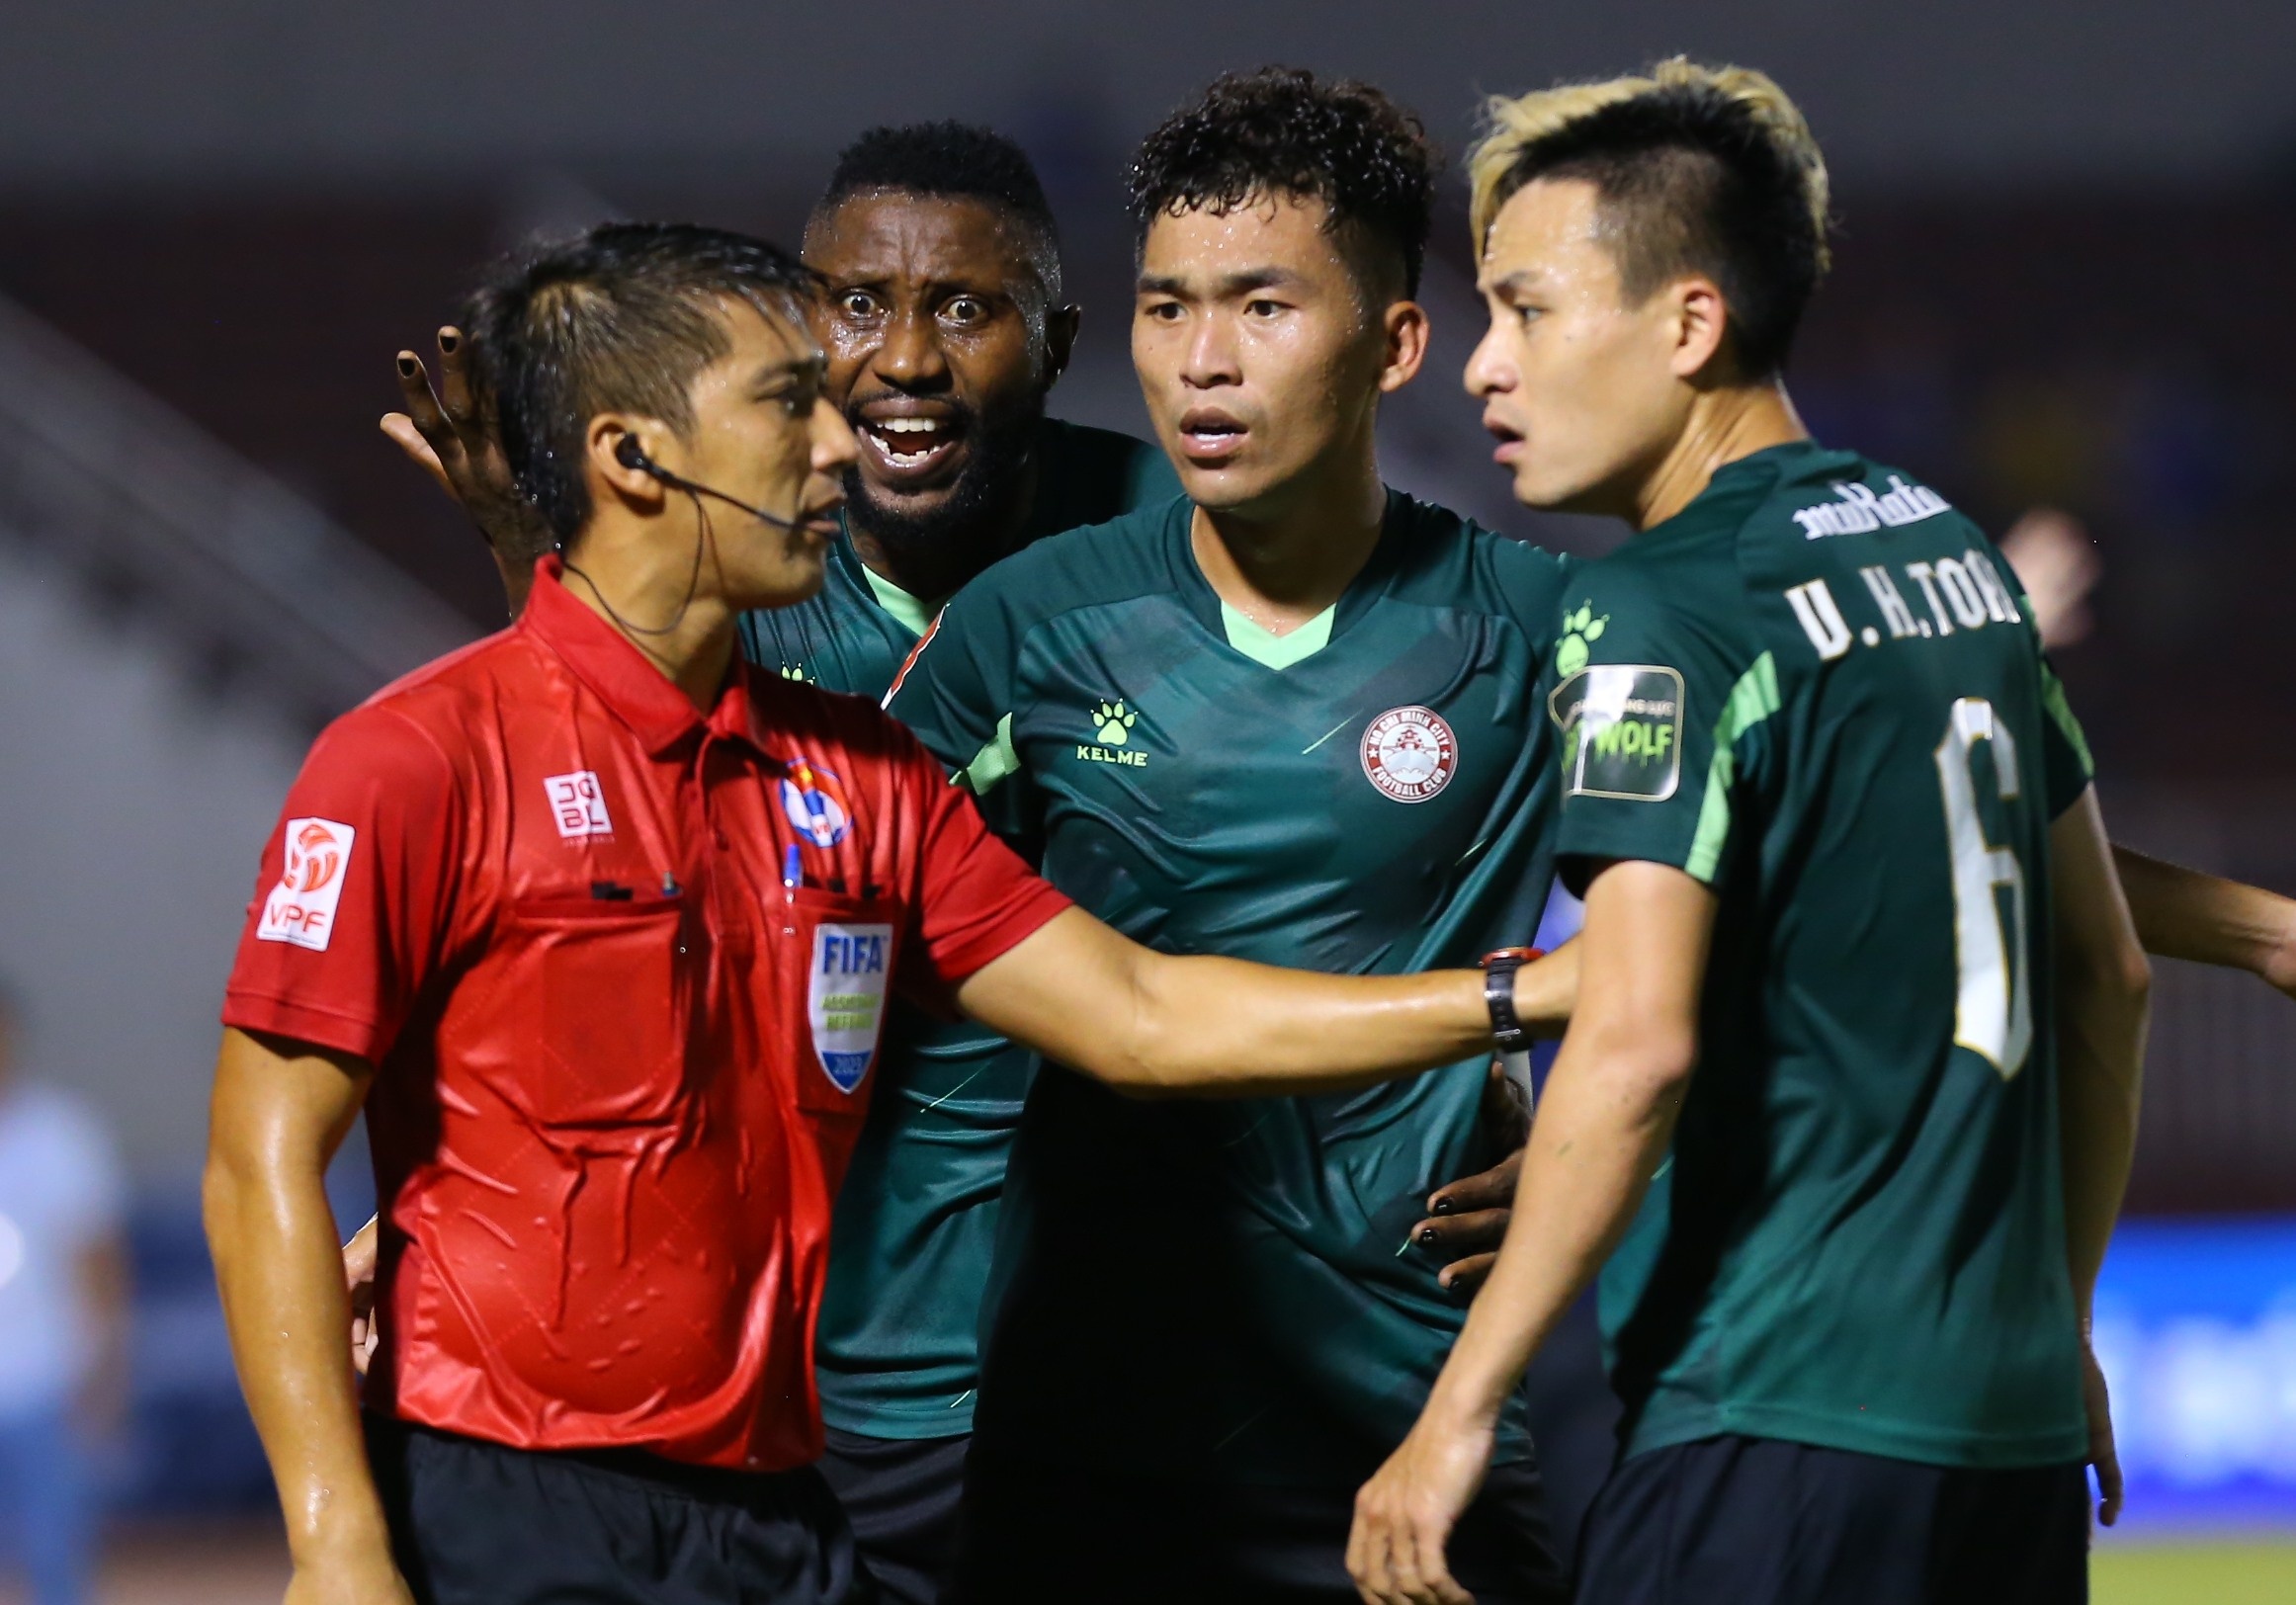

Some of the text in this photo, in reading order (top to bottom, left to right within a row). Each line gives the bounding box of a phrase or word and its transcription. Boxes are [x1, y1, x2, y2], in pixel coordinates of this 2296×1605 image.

[1368, 711, 1451, 745] HO CHI MINH CITY
[1076, 745, 1148, 767] KELME
[1372, 766, 1447, 797] FOOTBALL CLUB
[1932, 696, 2034, 1083] 6
[270, 903, 326, 933] VPF
[823, 935, 884, 974] FIFA
